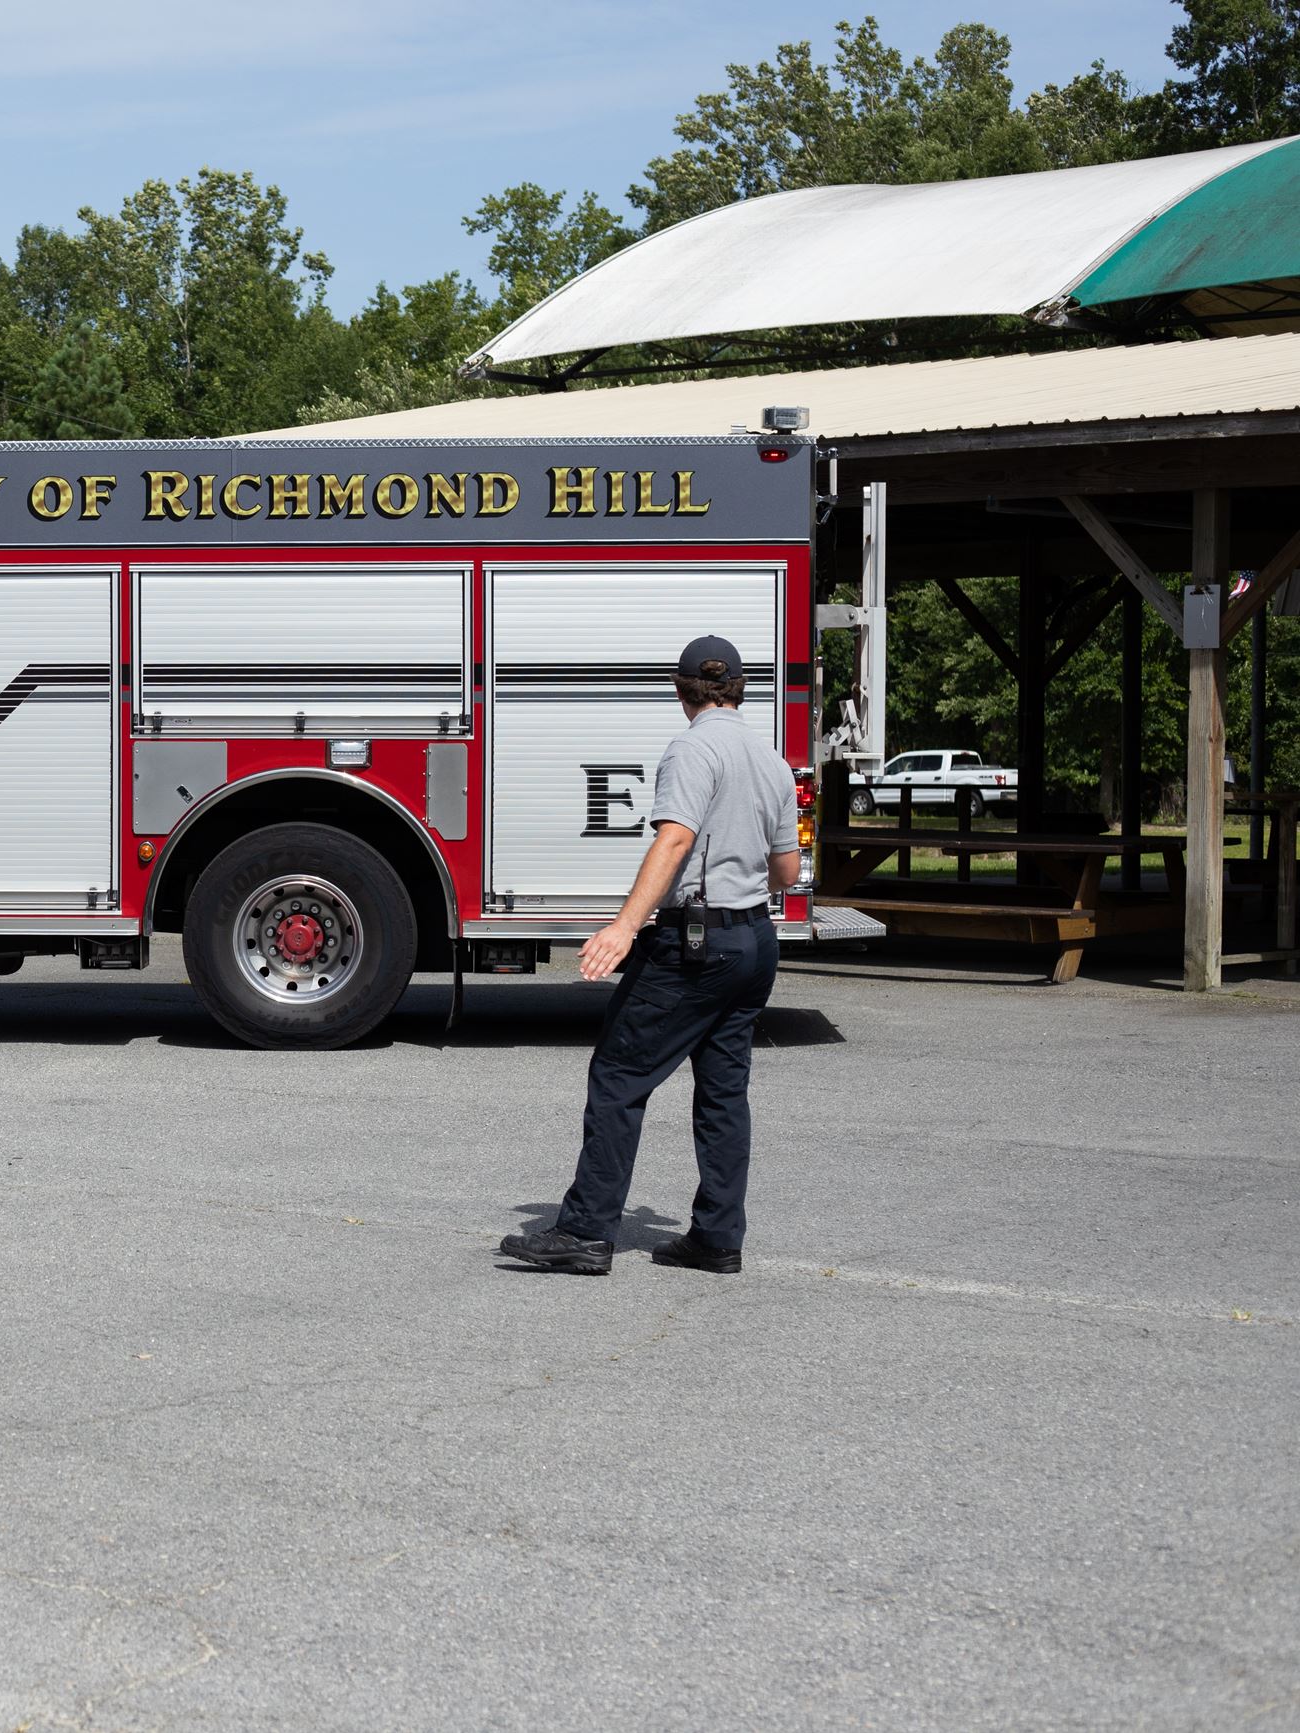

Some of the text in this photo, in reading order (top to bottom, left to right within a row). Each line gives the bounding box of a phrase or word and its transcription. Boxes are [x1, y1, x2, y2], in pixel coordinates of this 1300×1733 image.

[27, 474, 117, 522] OF
[141, 470, 521, 521] RICHMOND
[545, 466, 712, 518] HILL
[579, 763, 658, 838] E
